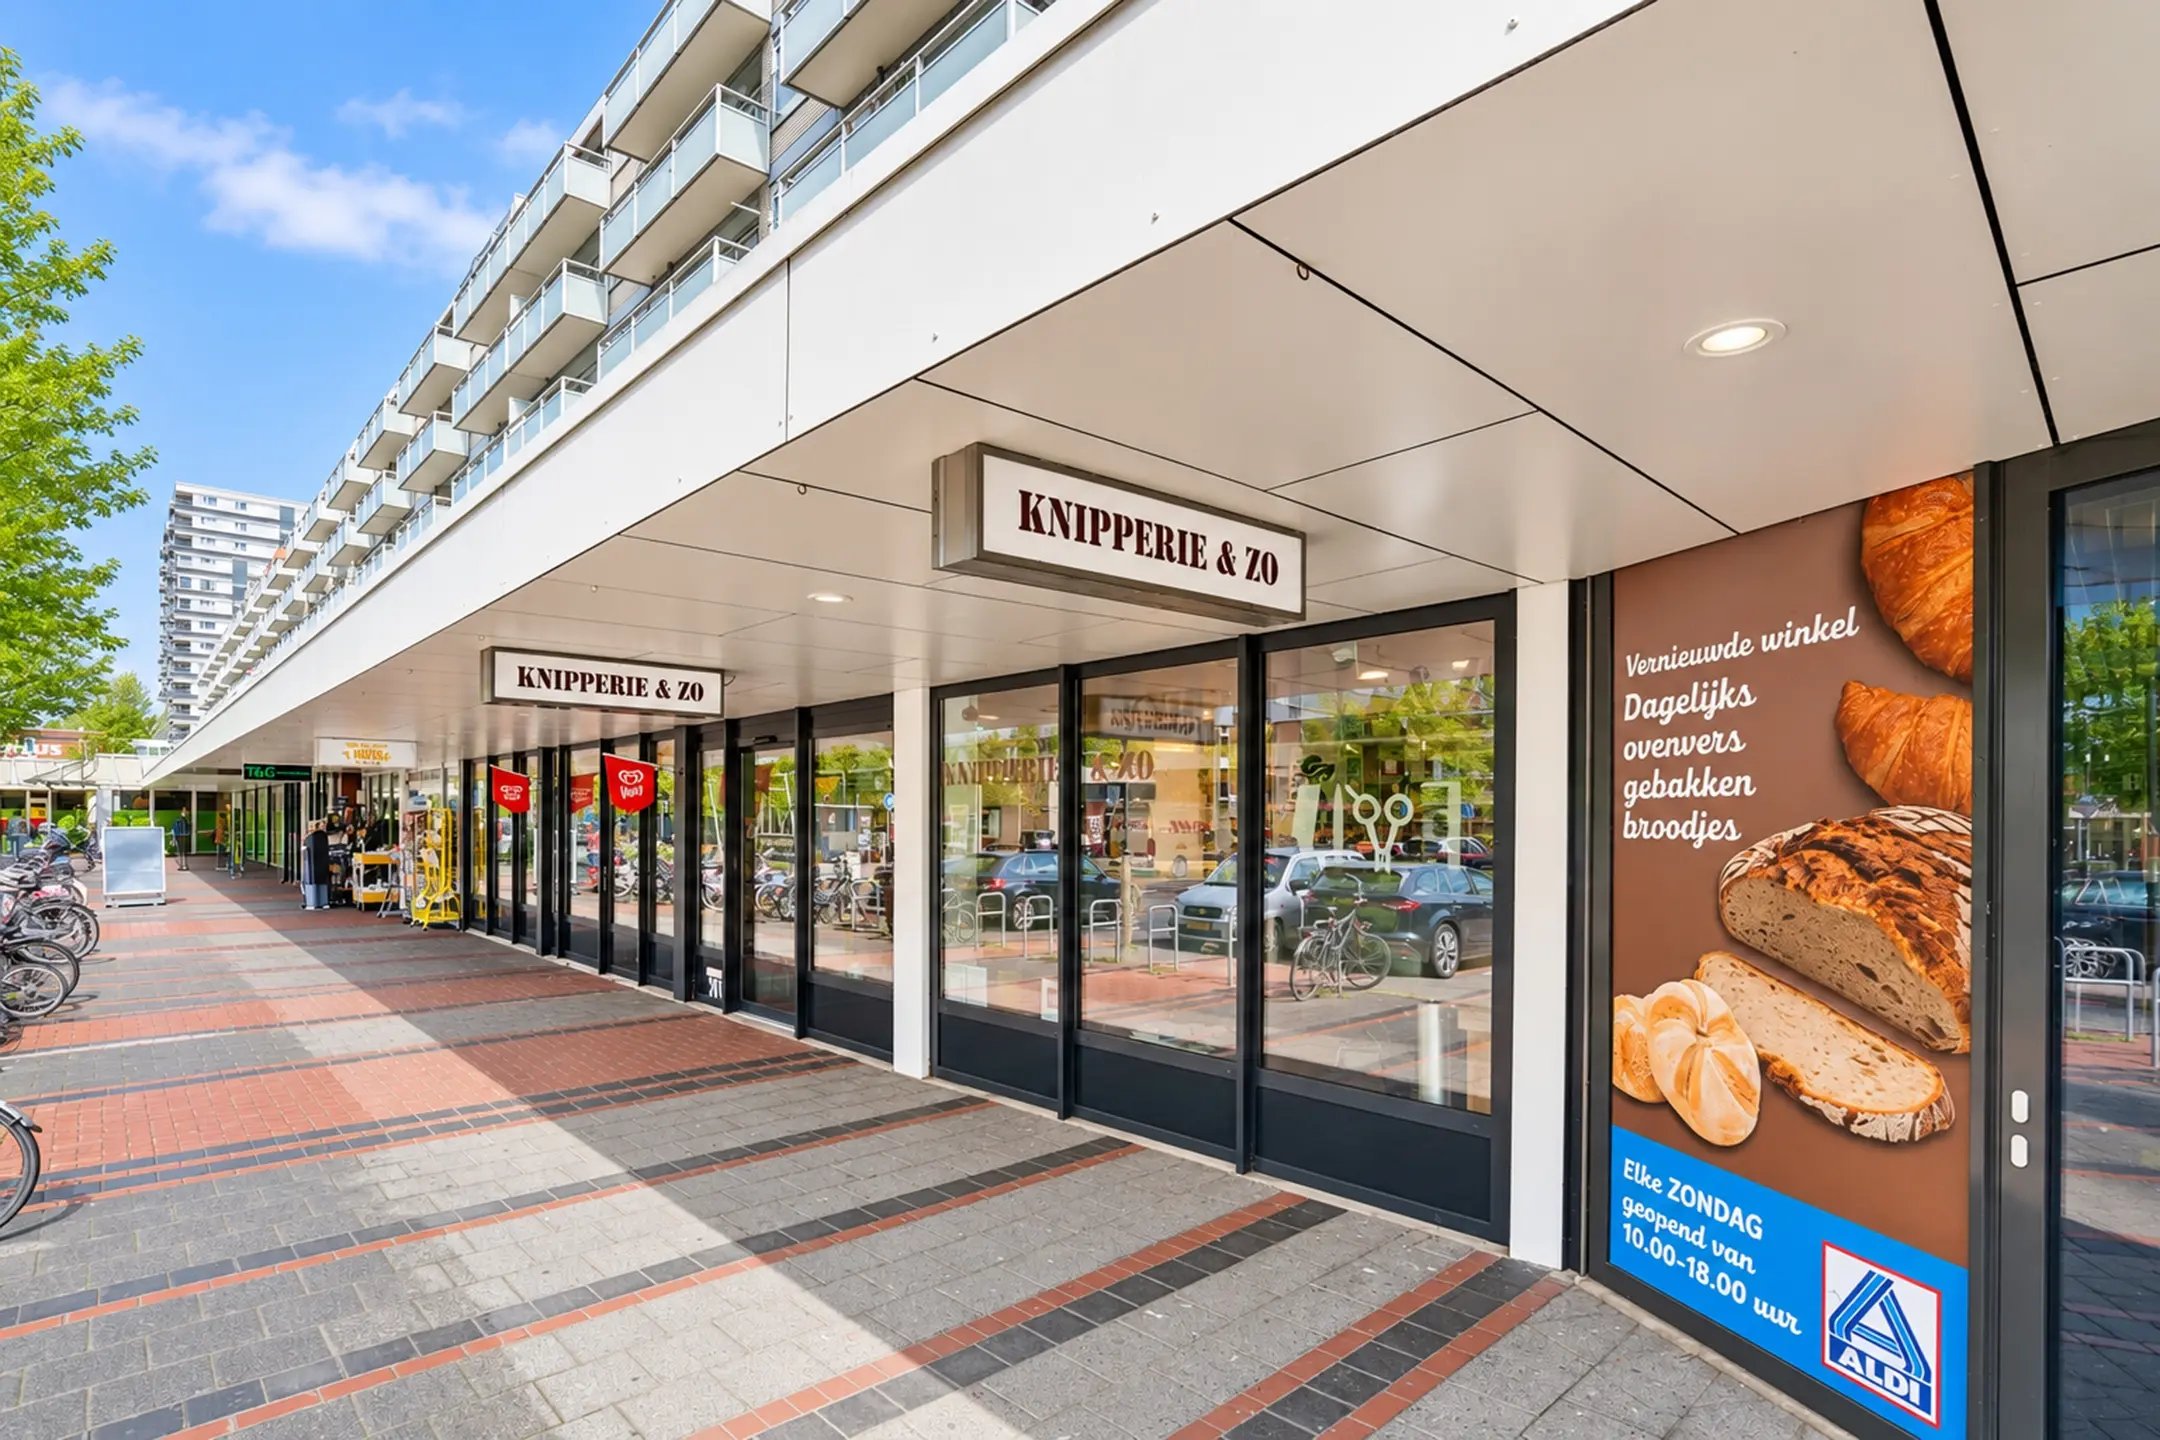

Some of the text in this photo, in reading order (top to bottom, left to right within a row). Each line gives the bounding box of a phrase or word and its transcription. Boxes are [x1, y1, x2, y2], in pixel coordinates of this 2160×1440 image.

[1019, 490, 1278, 585] KNIPPERIE & ZO
[1626, 606, 1859, 676] Vernieuwde winkel
[517, 666, 704, 701] KNIPPERIE & ZO
[1625, 678, 1757, 725] Dagelijks
[1624, 731, 1745, 760] ovenvers
[1624, 767, 1756, 808] gebakken
[1624, 811, 1742, 848] broodjes
[1625, 1159, 1762, 1239] Elke ZONDAG
[1624, 1197, 1755, 1273] geopend van
[1624, 1224, 1802, 1335] 10.00-18.00 uur
[1839, 1346, 1921, 1404] ALDI
